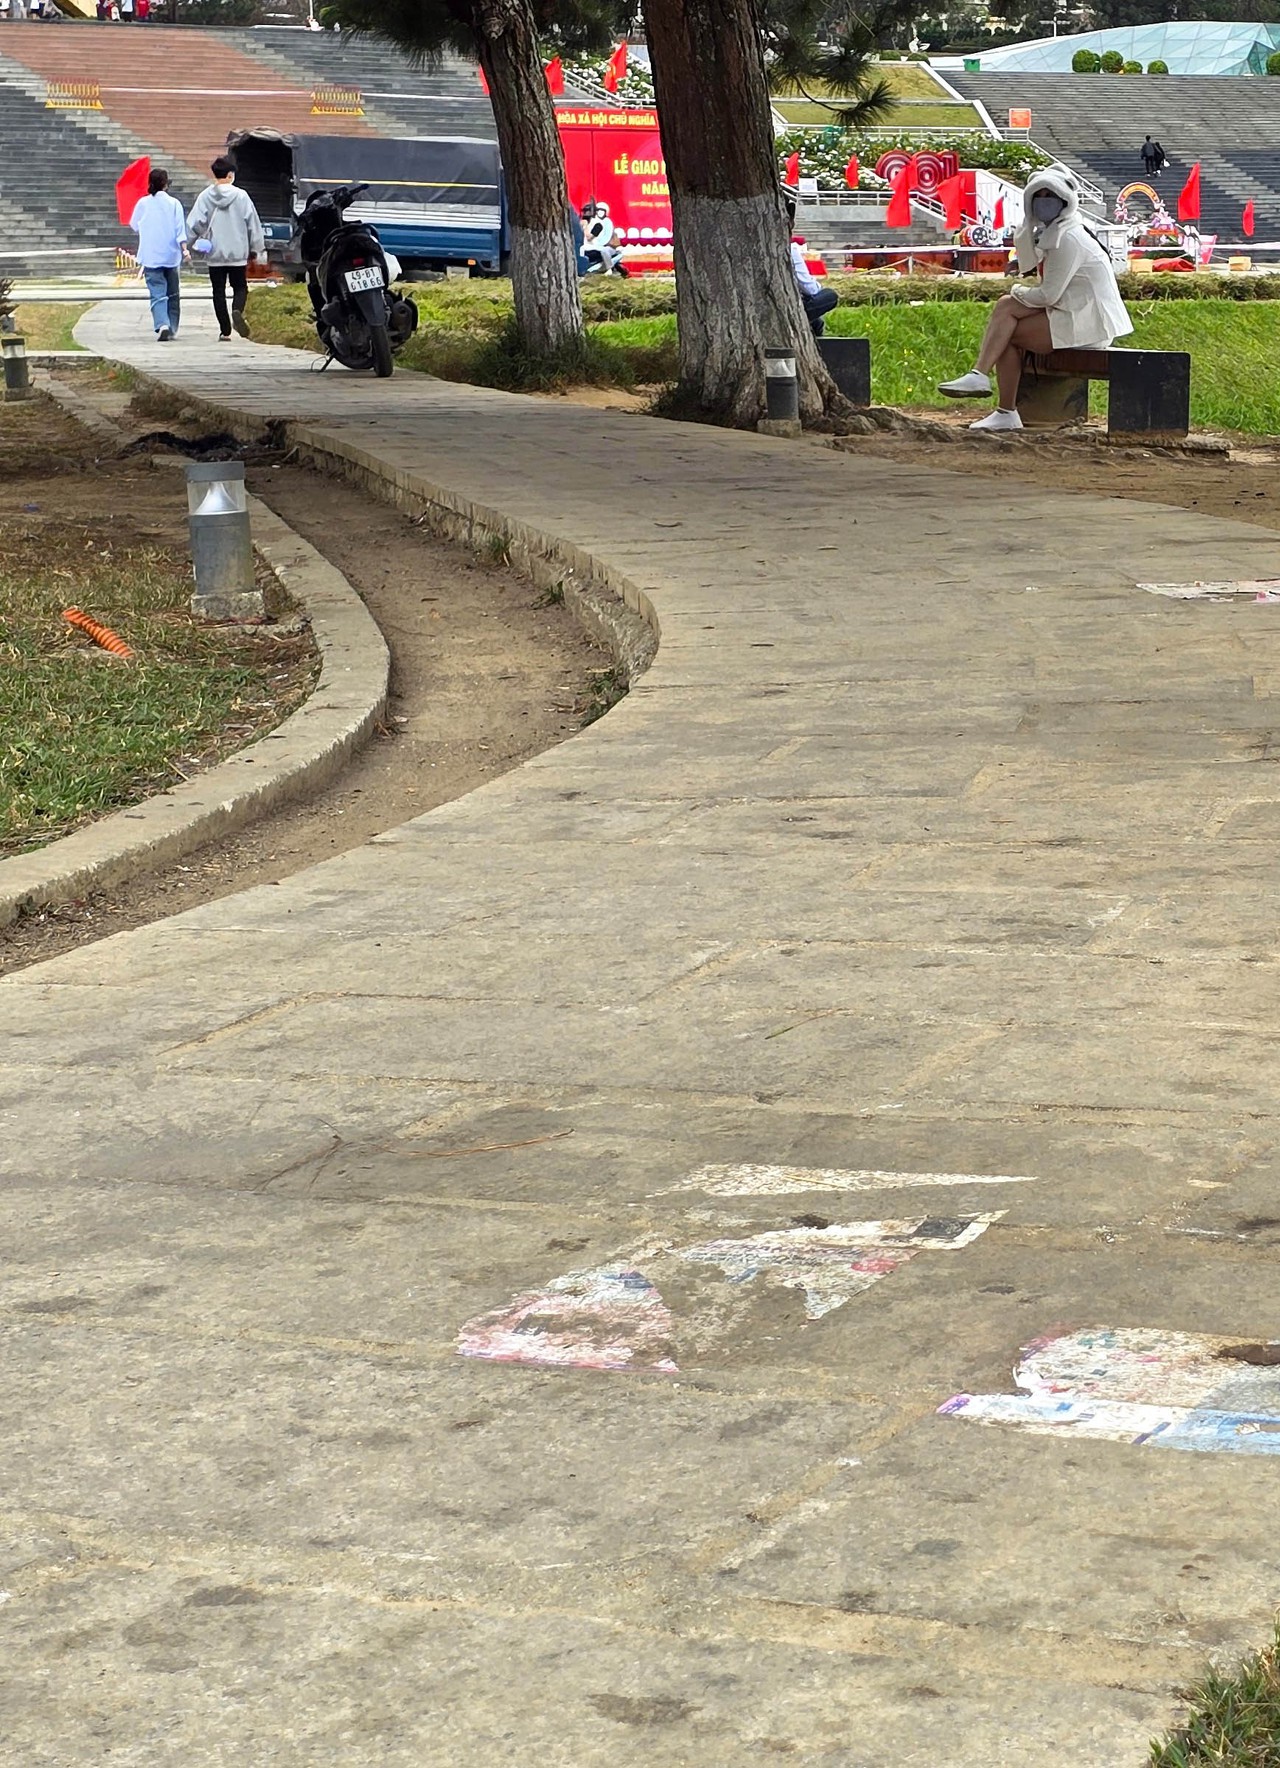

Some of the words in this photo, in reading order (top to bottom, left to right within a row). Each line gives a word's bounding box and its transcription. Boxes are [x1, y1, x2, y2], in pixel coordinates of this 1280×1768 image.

[578, 111, 591, 124] XÃ
[592, 112, 607, 127] HỘI
[609, 111, 627, 125] CHỦ
[628, 113, 656, 125] NGHĨA
[614, 153, 629, 174] LỄ
[631, 159, 659, 175] GIAO
[642, 180, 670, 195] NĂM
